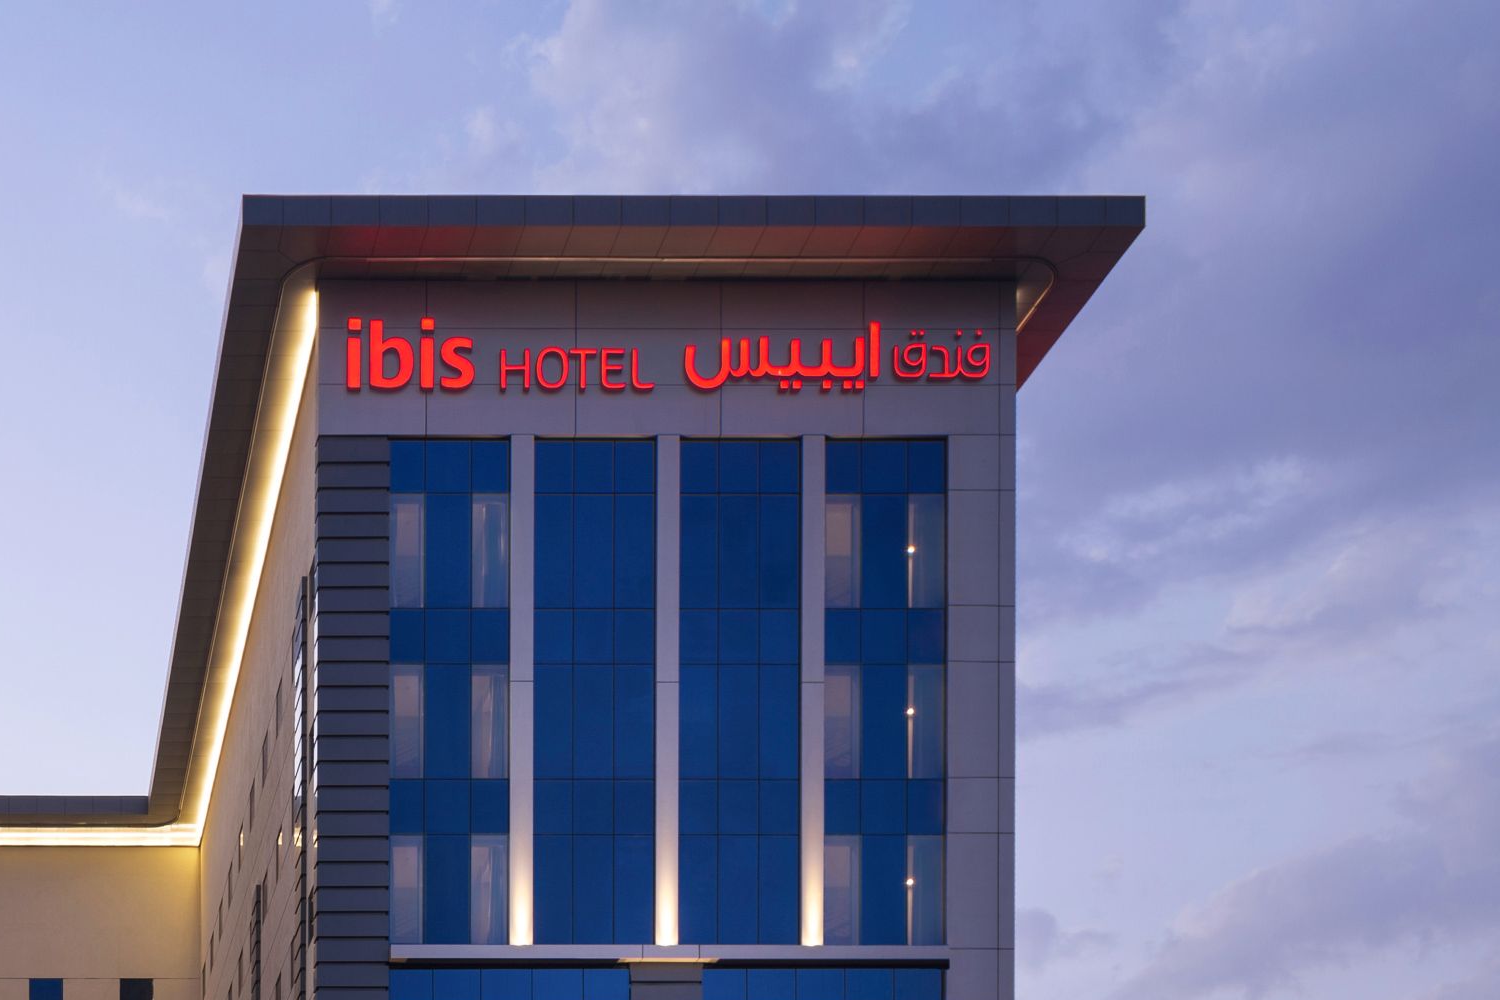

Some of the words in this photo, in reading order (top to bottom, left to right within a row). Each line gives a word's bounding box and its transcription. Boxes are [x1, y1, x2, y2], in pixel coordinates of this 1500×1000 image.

[347, 317, 476, 390] ibis
[499, 346, 655, 390] HOTEL
[684, 320, 880, 390] ايبيس
[894, 328, 990, 378] فندق
